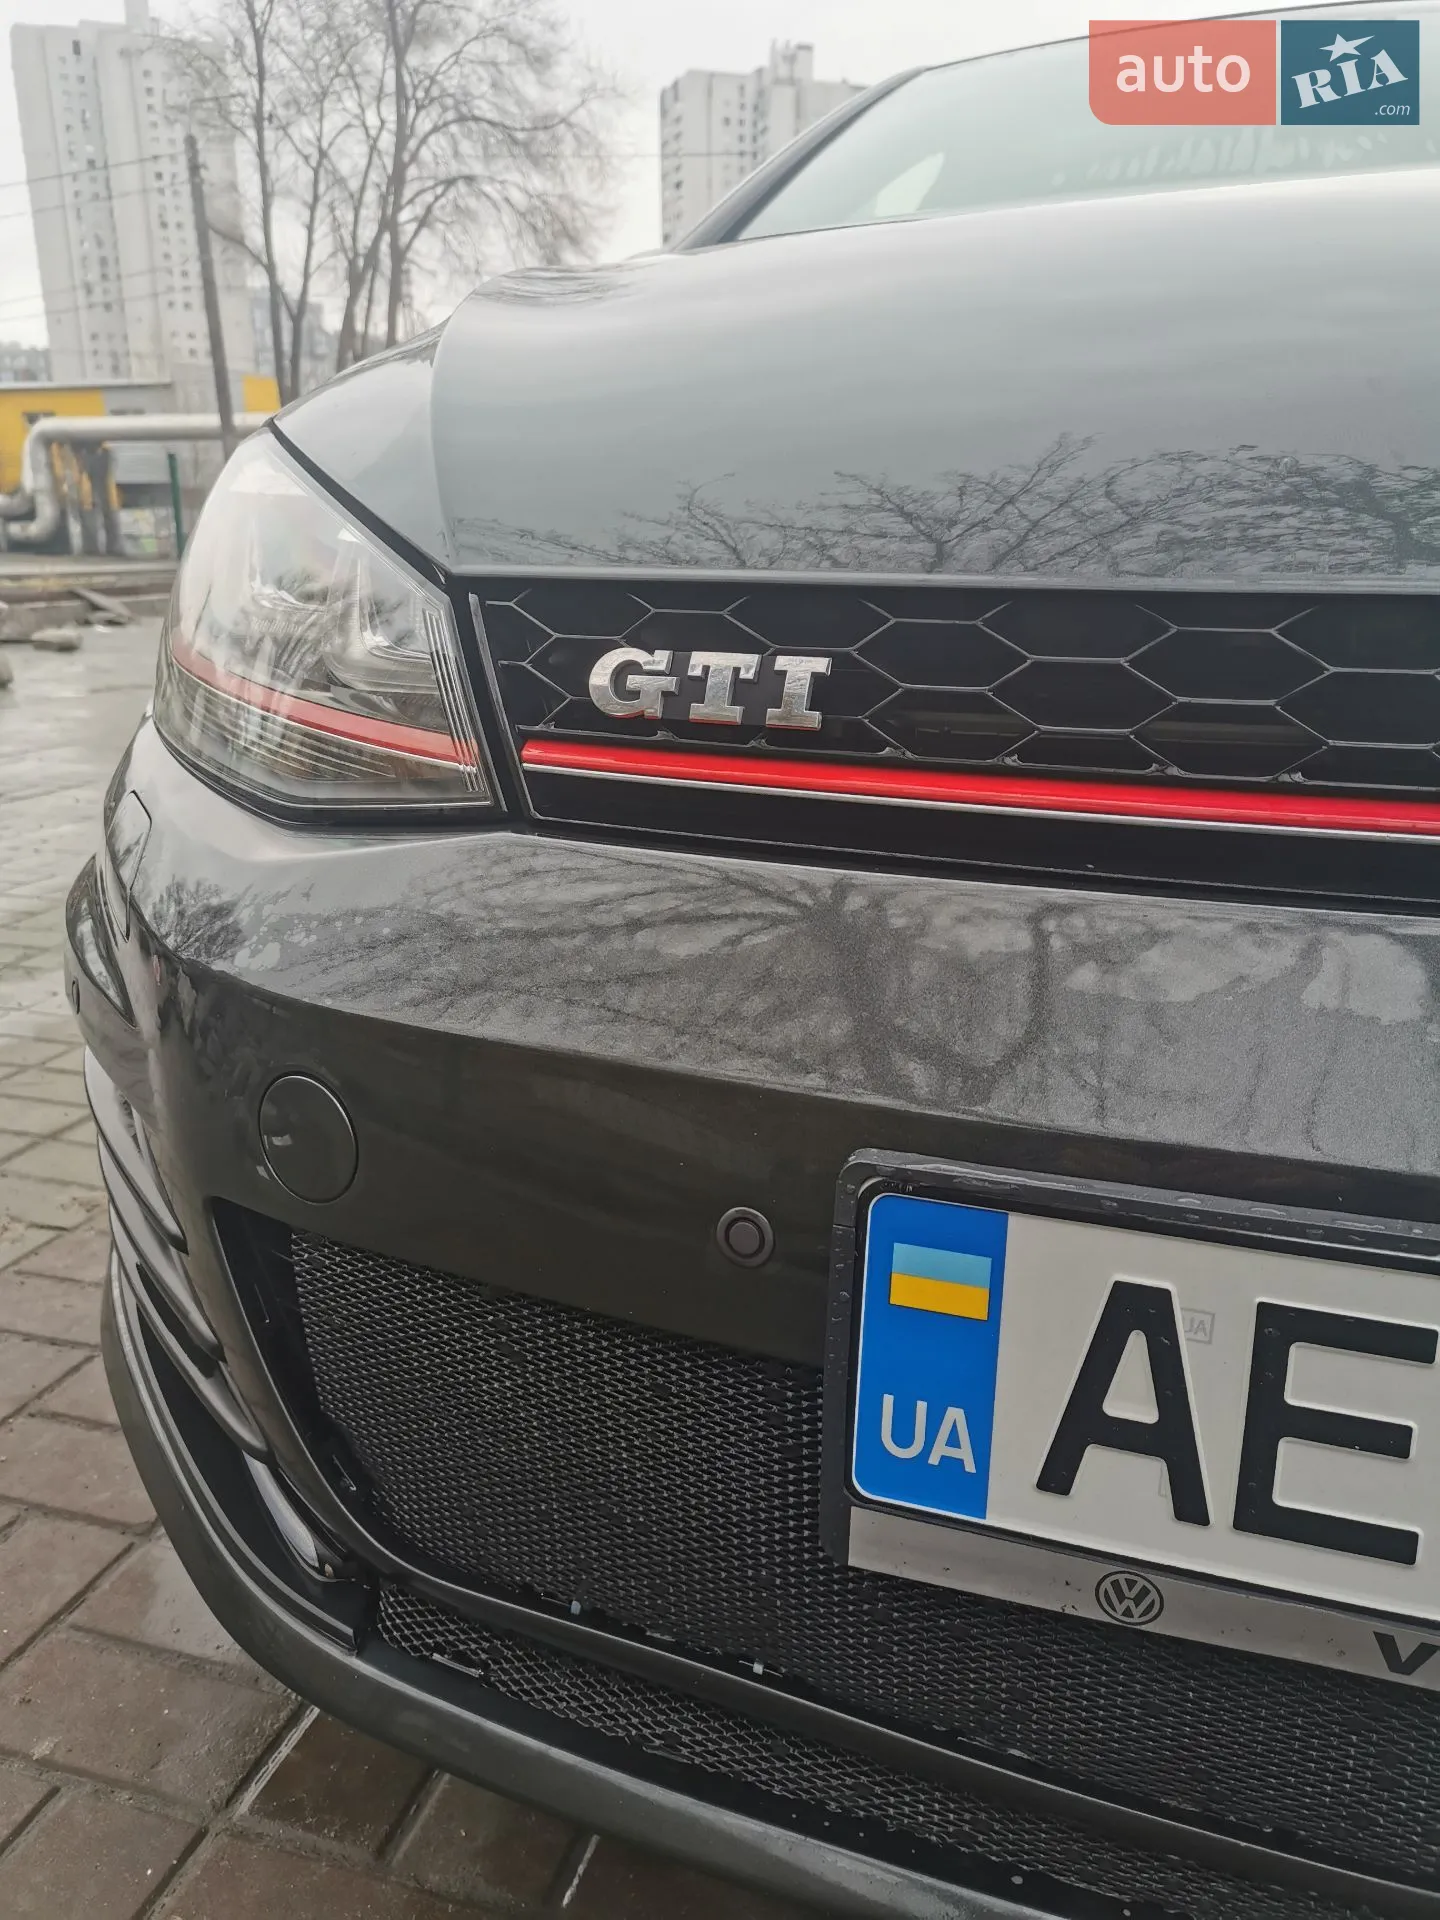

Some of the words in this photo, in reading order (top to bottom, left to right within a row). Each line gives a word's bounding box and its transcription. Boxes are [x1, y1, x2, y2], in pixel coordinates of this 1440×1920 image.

[588, 648, 832, 731] GTI
[880, 1394, 977, 1474] UA
[1035, 1279, 1439, 1566] AE
